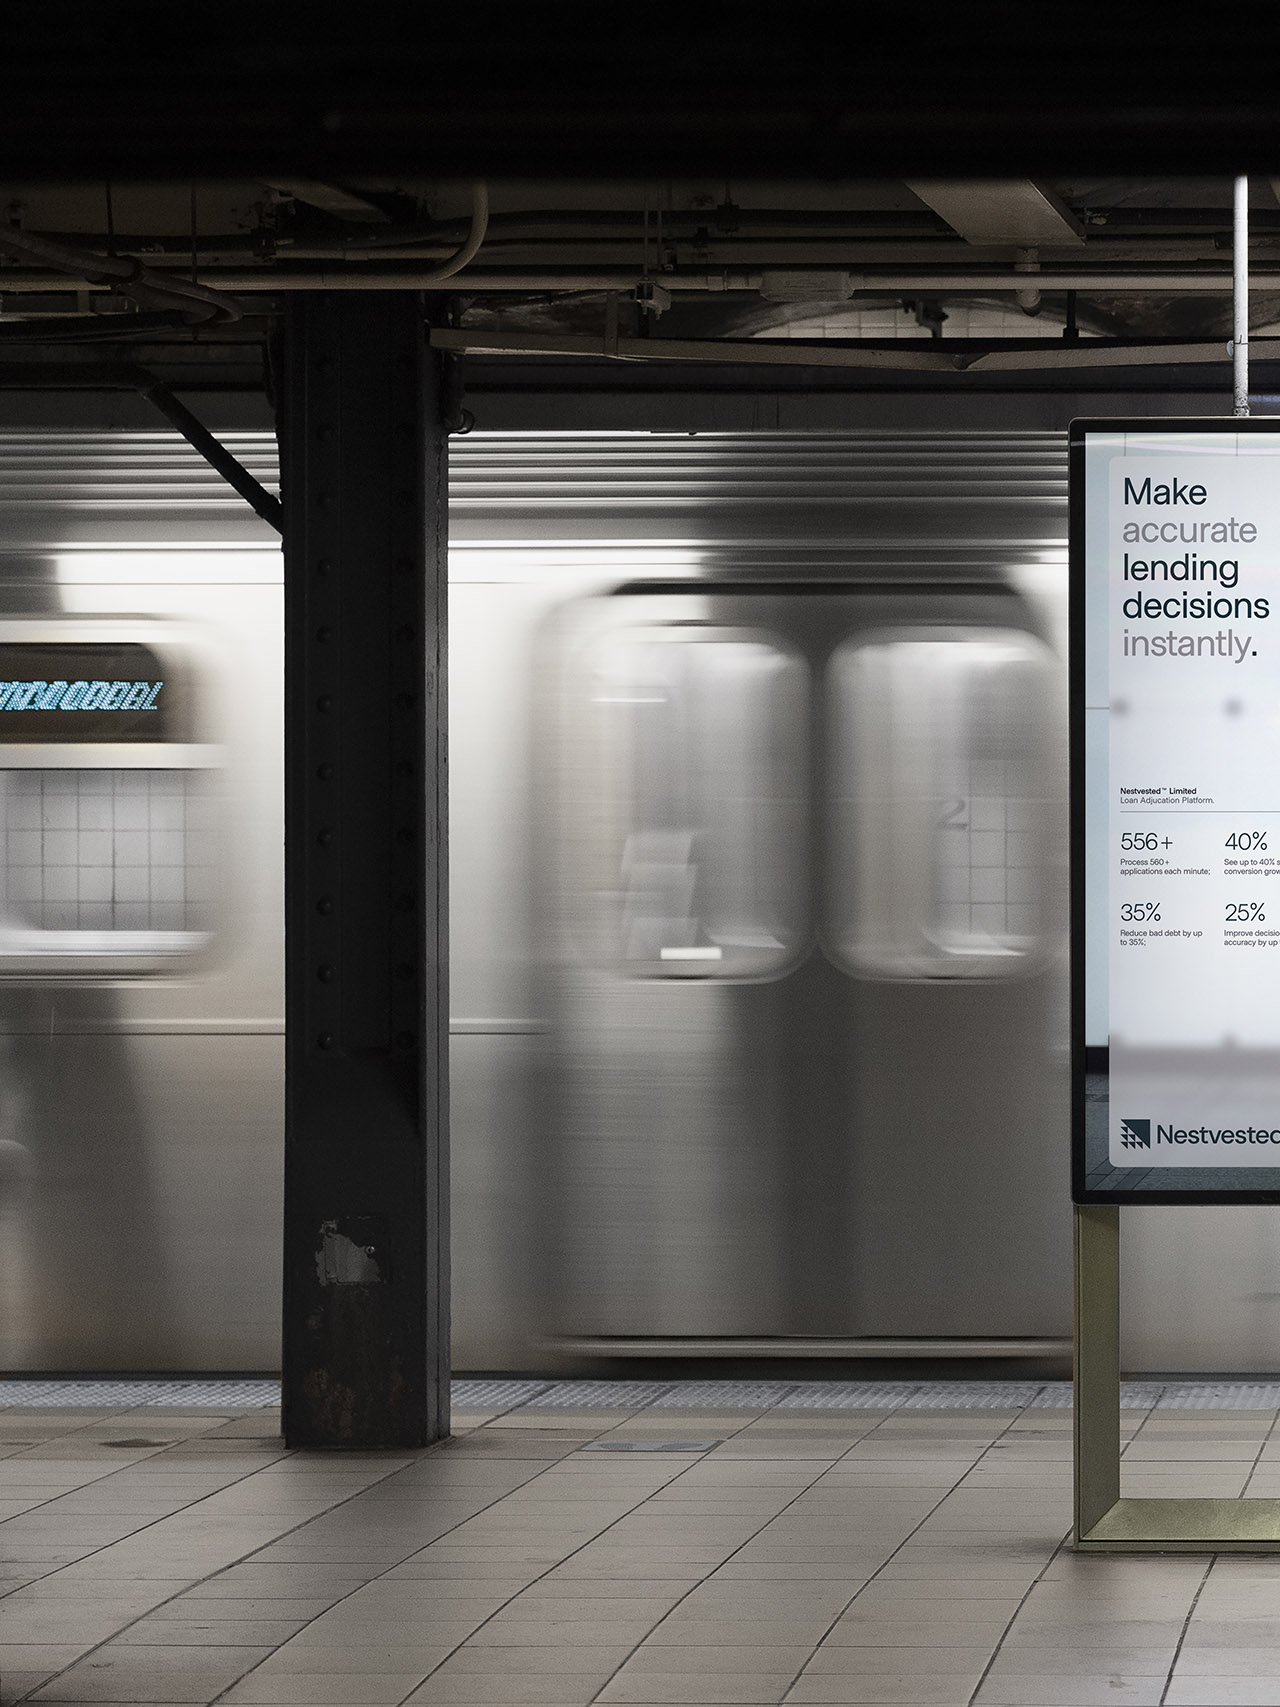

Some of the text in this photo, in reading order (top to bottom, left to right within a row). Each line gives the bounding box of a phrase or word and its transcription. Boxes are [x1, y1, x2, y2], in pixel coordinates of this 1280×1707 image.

[1125, 477, 1207, 505] Make
[1123, 517, 1257, 544] accurate
[1124, 553, 1238, 588] lending
[1123, 591, 1269, 619] decisions
[1124, 629, 1258, 664] instantly.
[1140, 797, 1180, 805] Adjucation
[1225, 832, 1267, 850] 40%
[1120, 868, 1163, 876] applications
[1121, 903, 1161, 921] 35%
[1225, 903, 1265, 921] 25%
[1183, 930, 1191, 938] by
[1224, 930, 1253, 938] Improve
[1258, 939, 1267, 947] by
